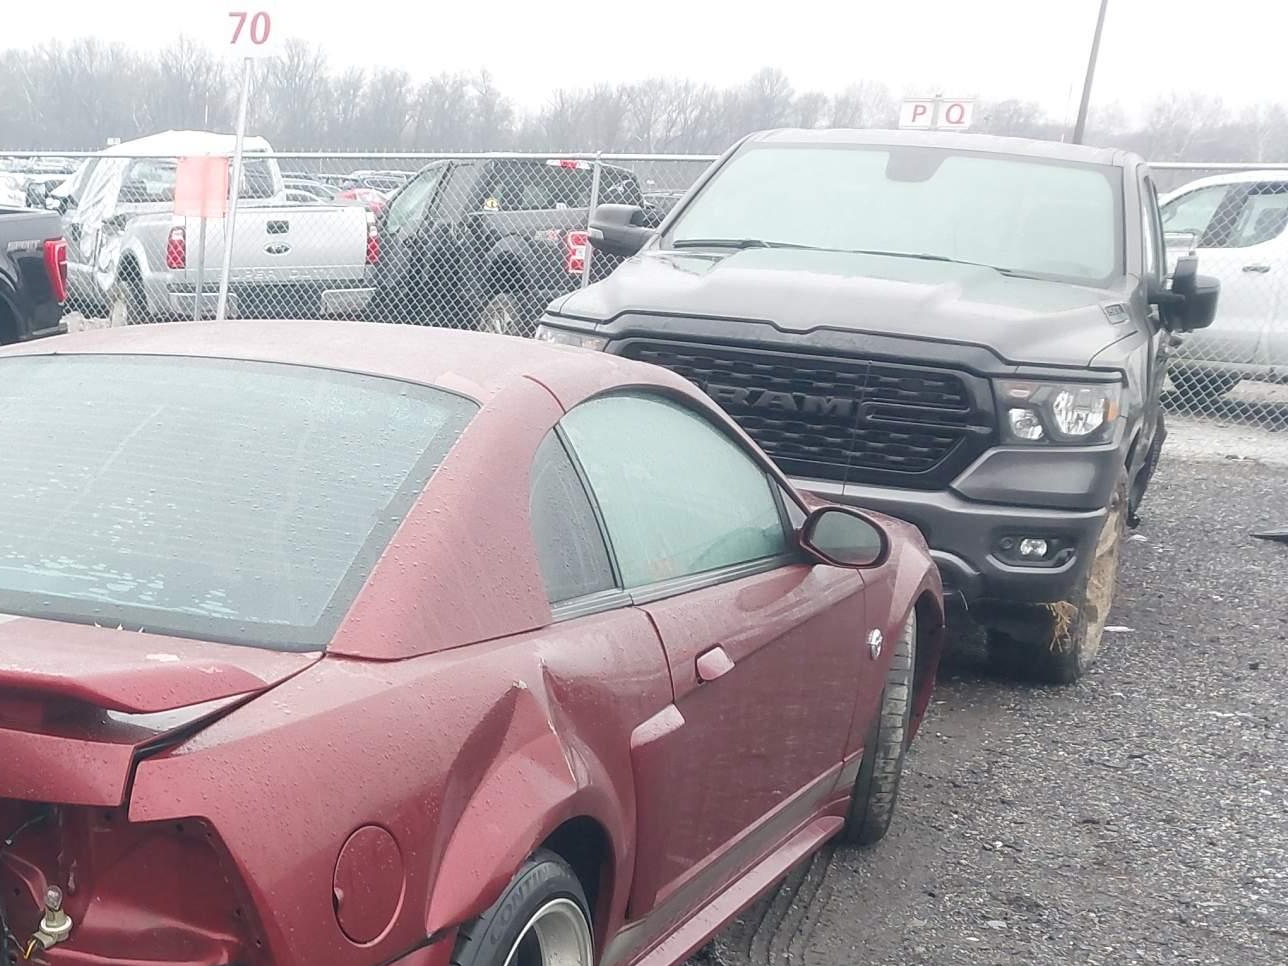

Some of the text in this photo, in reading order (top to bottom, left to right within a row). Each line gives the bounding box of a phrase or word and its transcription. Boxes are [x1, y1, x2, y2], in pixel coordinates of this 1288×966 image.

[228, 11, 271, 45] 70
[911, 103, 965, 124] P Q
[704, 383, 859, 418] RAM
